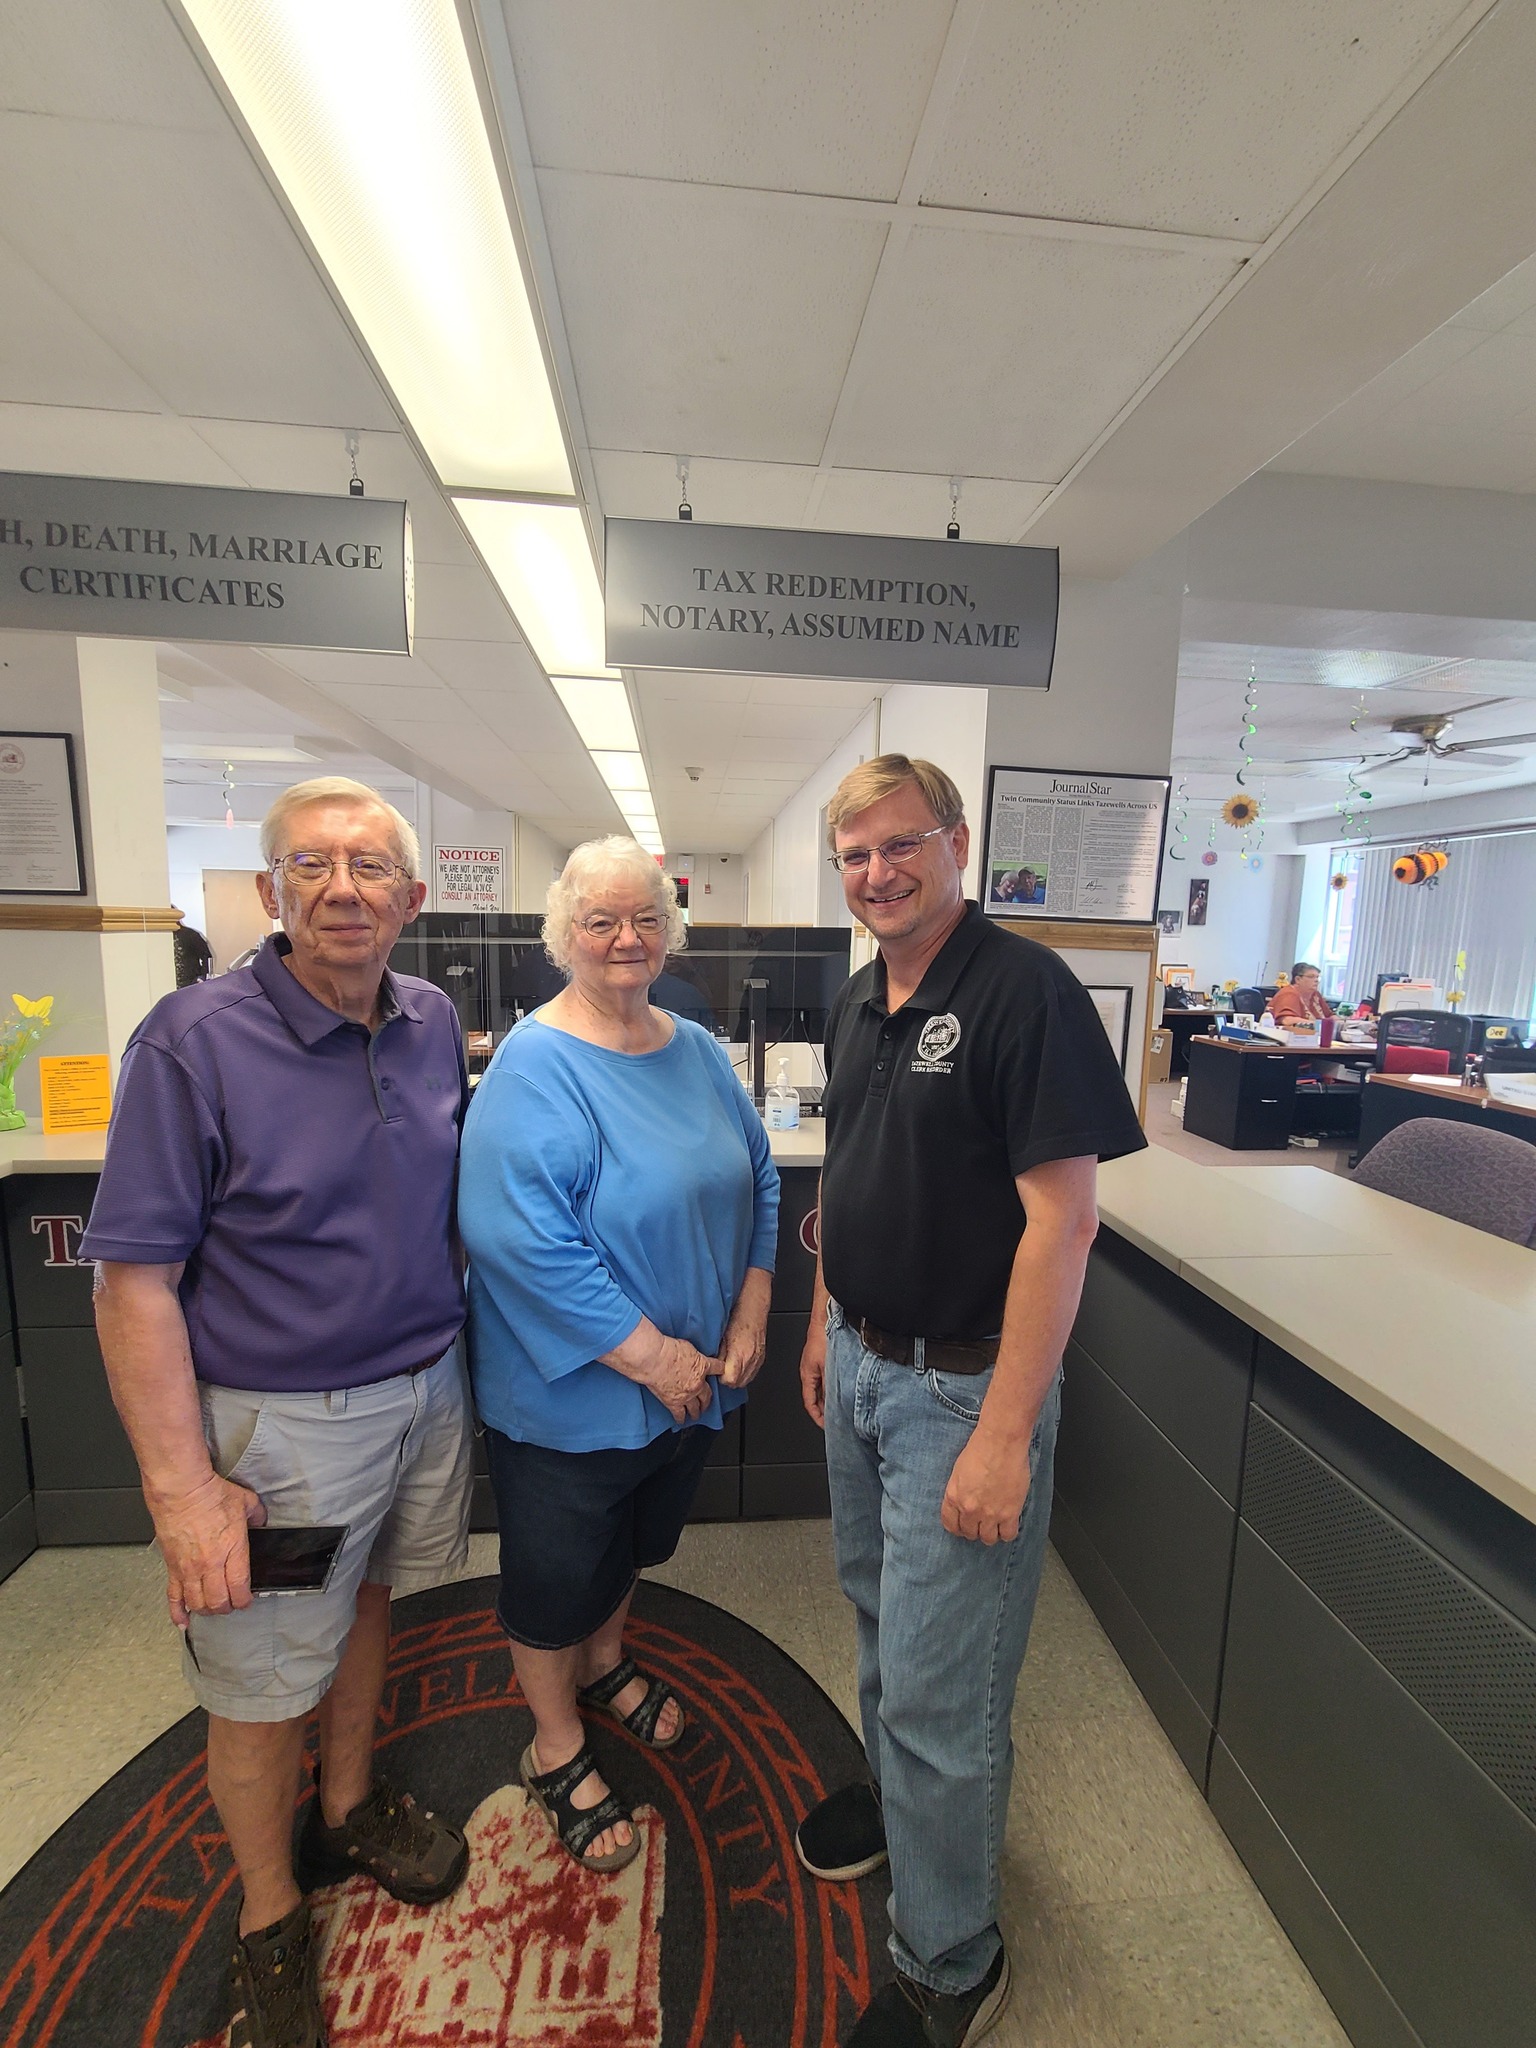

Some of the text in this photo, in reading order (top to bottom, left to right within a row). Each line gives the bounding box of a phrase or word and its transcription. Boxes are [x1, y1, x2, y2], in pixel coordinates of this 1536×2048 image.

[44, 521, 178, 561] DEATH,
[187, 532, 384, 571] MARRIAGE
[19, 565, 286, 609] CERTIFICATES
[692, 567, 977, 613] TAX REDEMPTION,
[640, 602, 1020, 649] NOTARY, ASSUMED NAME
[1000, 794, 1018, 803] Twin
[1018, 796, 1055, 805] Community
[1056, 797, 1076, 806] Status
[1077, 799, 1095, 807] Links
[1127, 802, 1148, 810] Across
[439, 849, 500, 861] NOTICE
[439, 864, 500, 875] WE ARE NOT ATTORNEYS
[444, 873, 495, 883] PLEASE DO NOT ASK
[446, 882, 457, 891] FOR
[457, 883, 474, 892] LEGAL
[441, 891, 498, 902] CONSULT AN ATTORNEY
[489, 903, 500, 912] You
